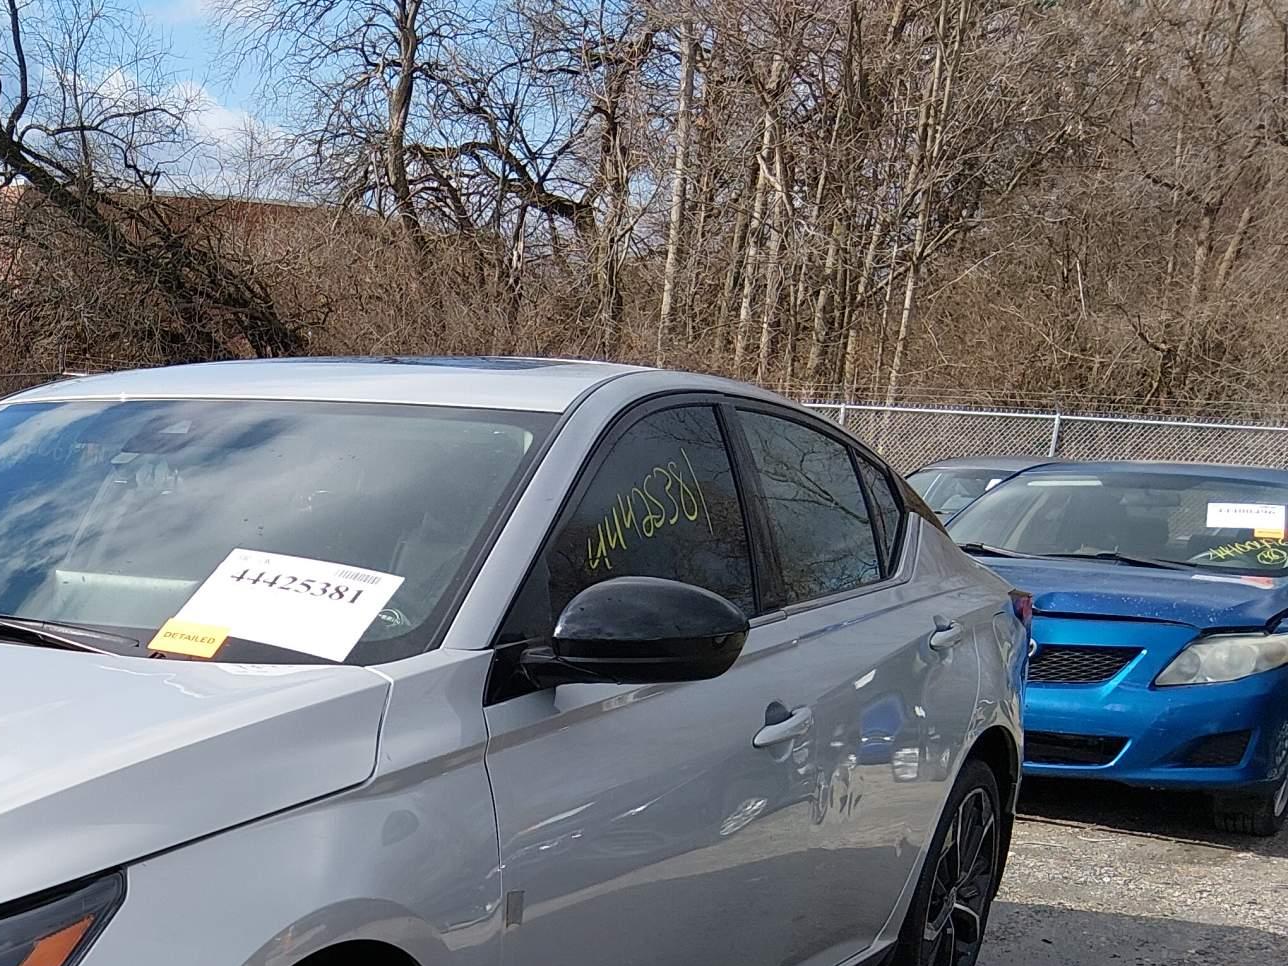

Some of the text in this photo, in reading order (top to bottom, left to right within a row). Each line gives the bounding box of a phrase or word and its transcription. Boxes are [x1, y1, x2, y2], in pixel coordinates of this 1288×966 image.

[586, 448, 713, 569] 44425381
[230, 568, 364, 604] 44425381
[163, 631, 216, 645] DETAILED
